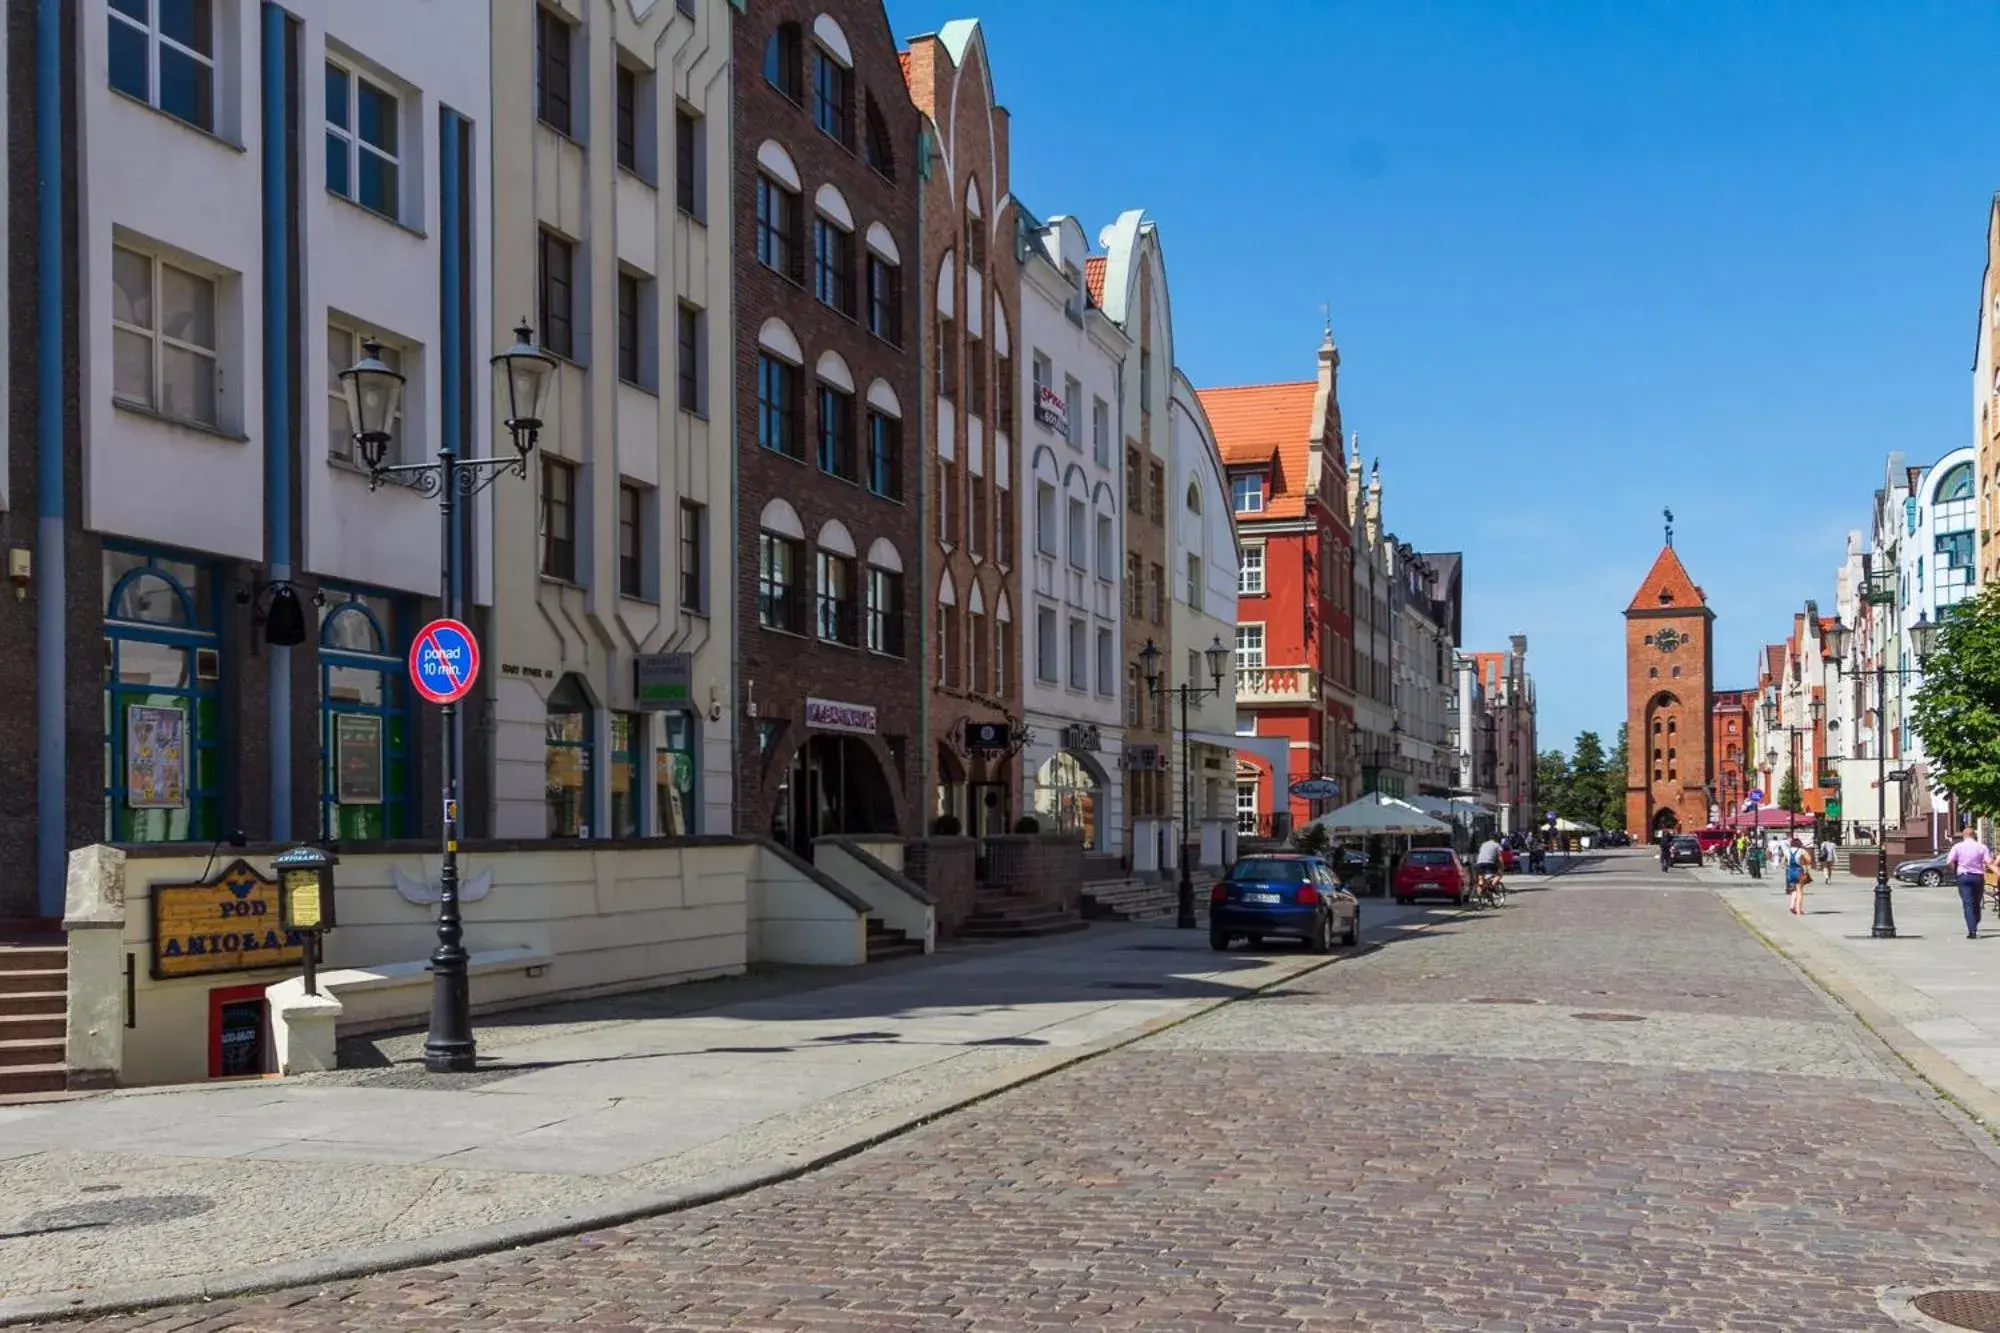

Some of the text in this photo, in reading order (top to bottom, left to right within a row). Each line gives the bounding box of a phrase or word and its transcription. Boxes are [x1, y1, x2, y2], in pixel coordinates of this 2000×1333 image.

[424, 646, 461, 662] ponad
[424, 663, 462, 676] 10 min.
[220, 901, 267, 918] POD
